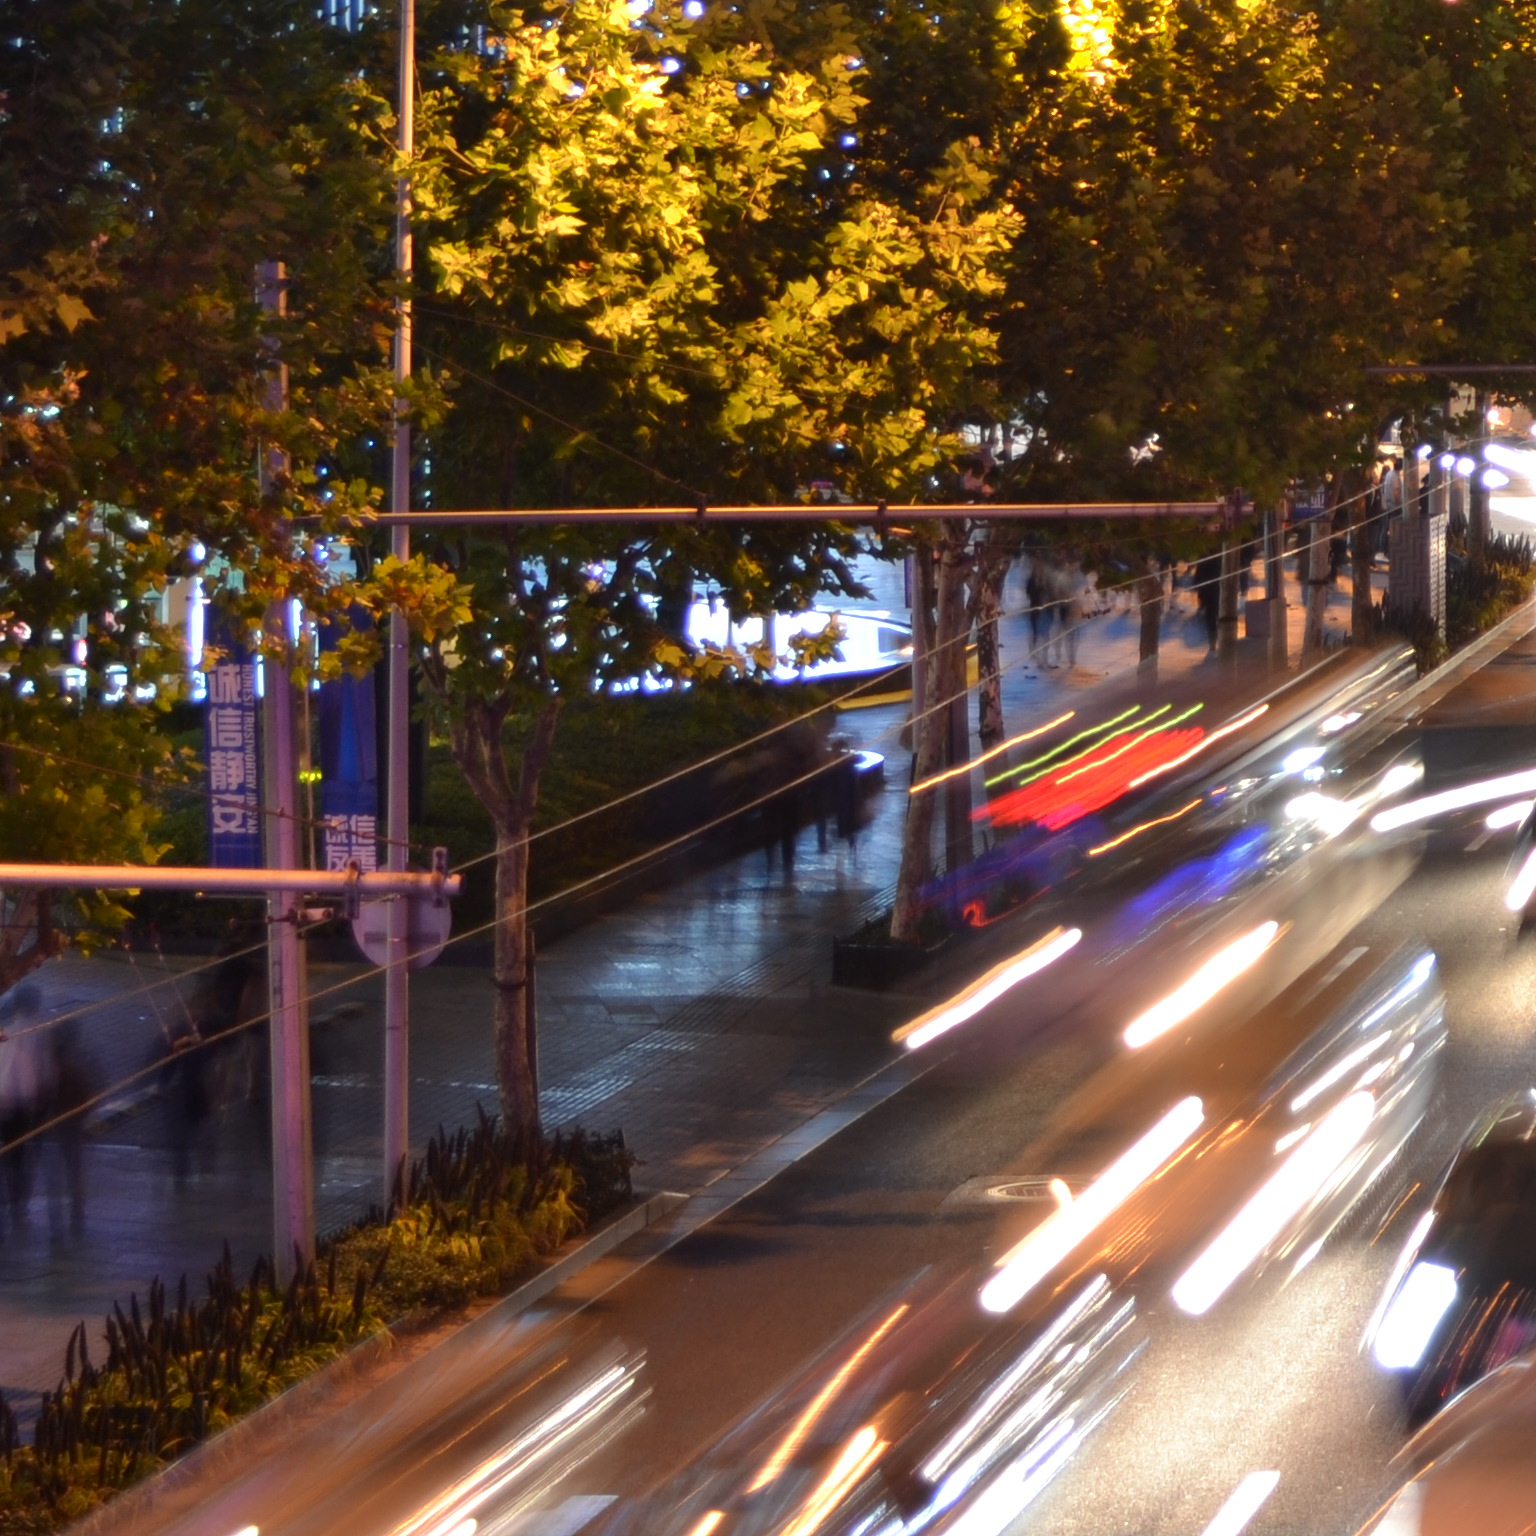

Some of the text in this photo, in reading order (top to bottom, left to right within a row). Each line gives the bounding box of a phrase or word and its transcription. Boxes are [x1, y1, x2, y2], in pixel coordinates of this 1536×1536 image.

[242, 664, 255, 706] HONEST
[208, 663, 246, 835] 诚信静安
[244, 710, 258, 790] TRUSTWORTHY
[323, 814, 377, 845] 诚信
